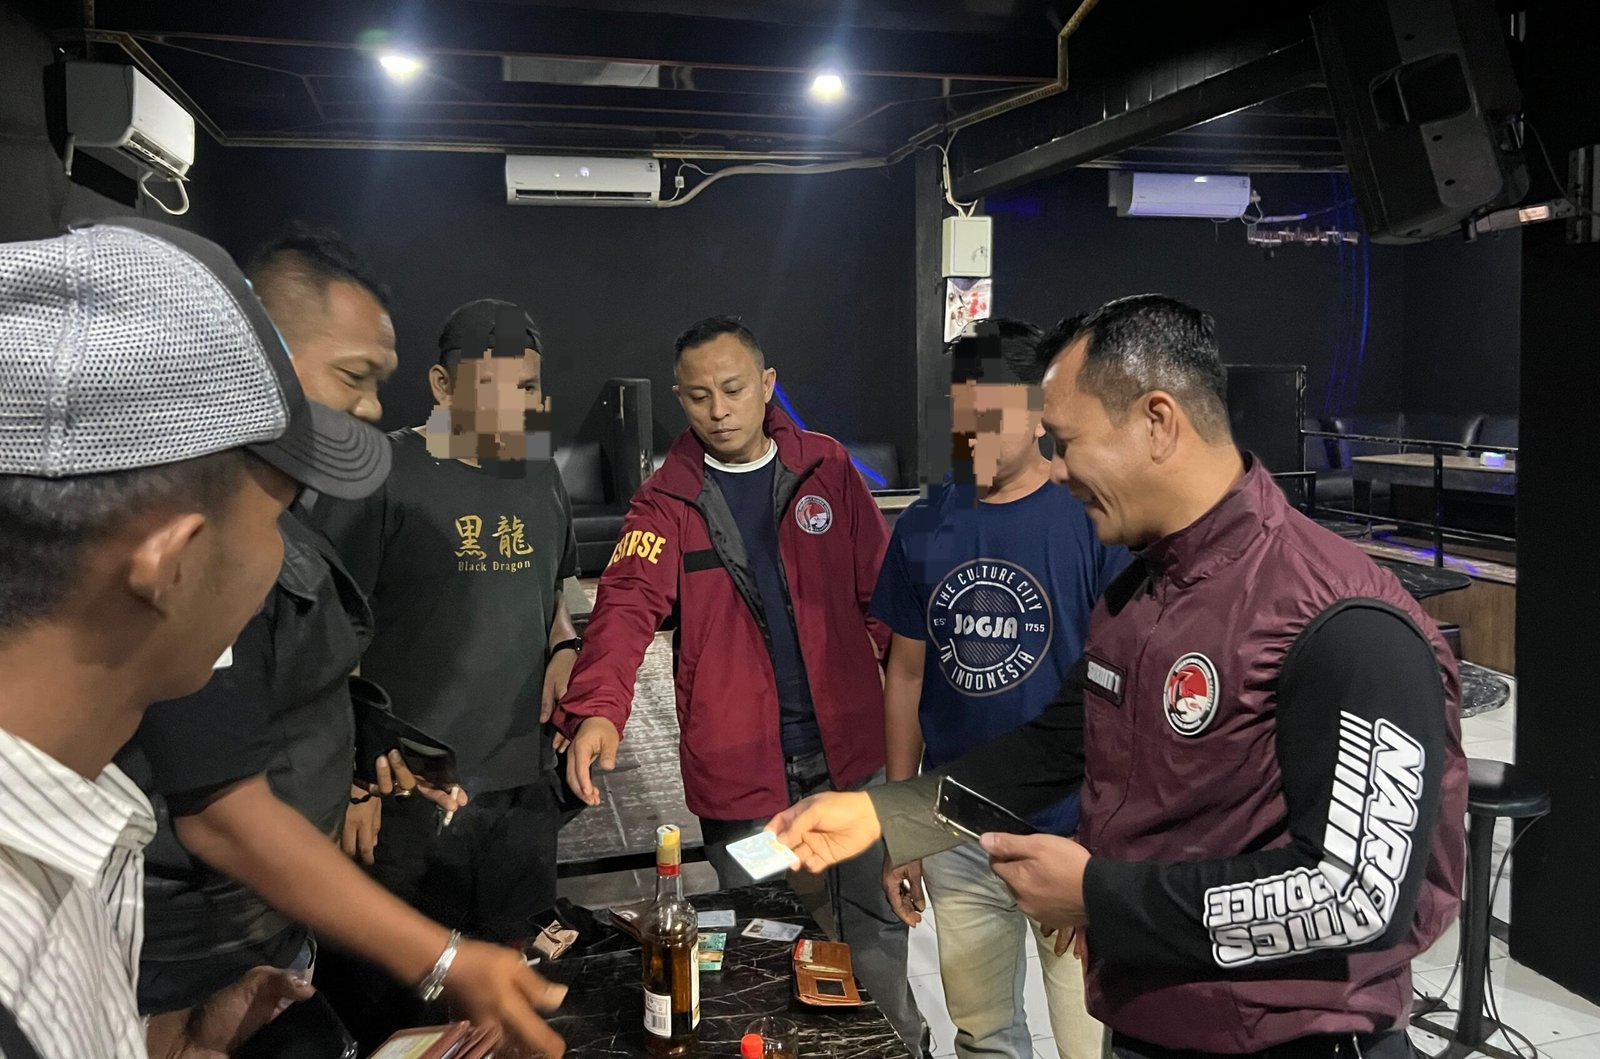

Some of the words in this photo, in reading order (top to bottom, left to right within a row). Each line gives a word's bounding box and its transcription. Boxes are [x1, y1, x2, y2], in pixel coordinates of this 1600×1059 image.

[458, 561, 487, 572] Black
[493, 560, 531, 572] Dragon
[936, 583, 956, 608] THE
[957, 565, 1016, 585] CULTURE
[1016, 580, 1043, 611] CITY
[954, 613, 1018, 639] JOGJA
[1025, 623, 1045, 633] 1755
[940, 644, 953, 663] IN
[951, 651, 1035, 691] INDONESIA
[1212, 718, 1425, 967] NARCOTICS
